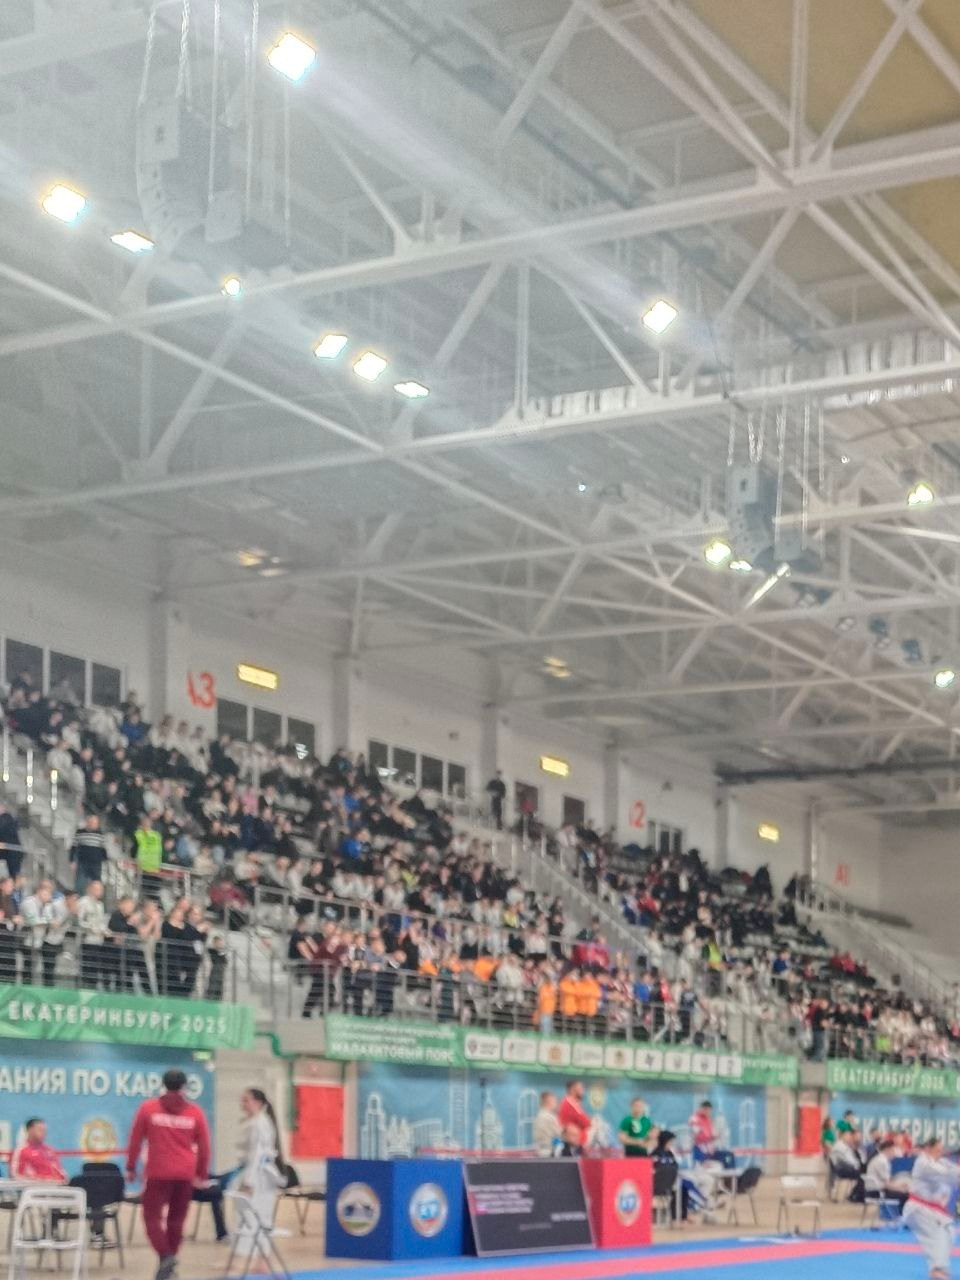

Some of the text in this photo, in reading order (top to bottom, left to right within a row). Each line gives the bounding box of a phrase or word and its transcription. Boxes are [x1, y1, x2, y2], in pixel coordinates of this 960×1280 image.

[8, 1000, 226, 1034] ЕКАТЕРИНБУРГ 2025
[72, 1069, 111, 1096] ПО
[115, 1071, 204, 1100] КАРЭ
[833, 1066, 915, 1089] ЕКАТЕРИНБУРГ
